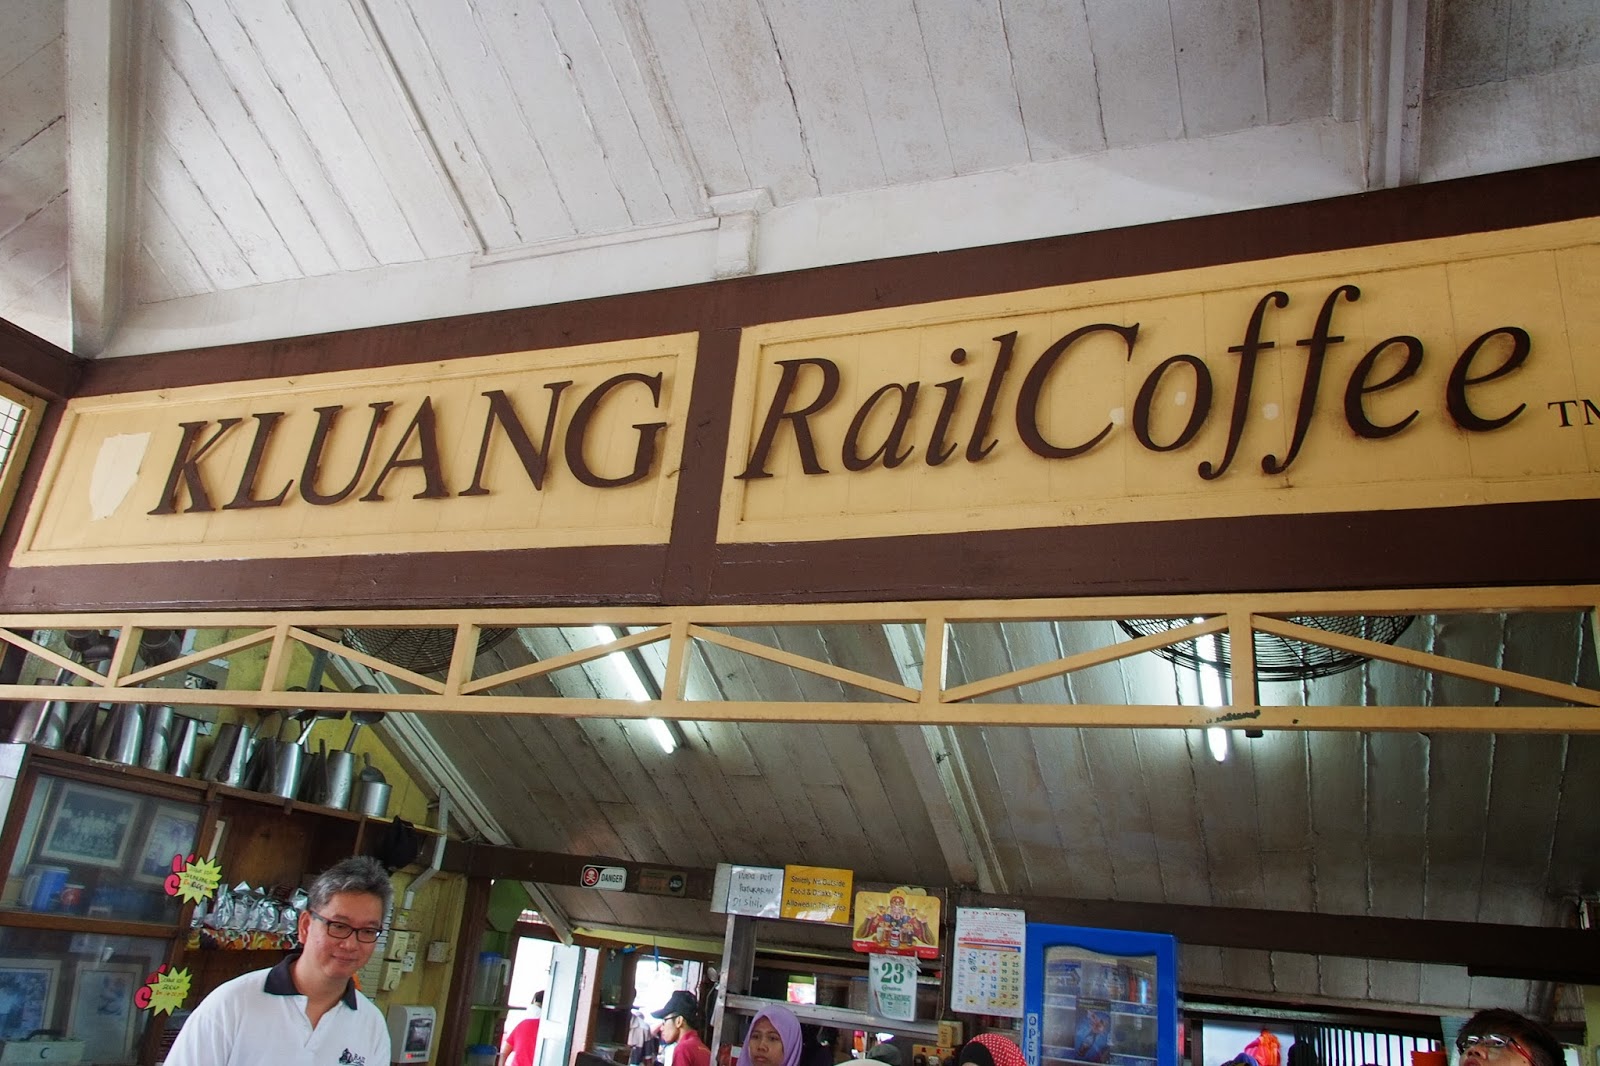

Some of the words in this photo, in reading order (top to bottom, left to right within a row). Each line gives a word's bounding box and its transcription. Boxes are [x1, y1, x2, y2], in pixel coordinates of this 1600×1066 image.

[146, 371, 669, 516] KLUANG
[601, 873, 623, 884] DANGER
[790, 875, 811, 886] Strictly
[822, 878, 846, 888] Outside
[790, 887, 806, 895] Food
[786, 899, 810, 908] Allowed
[880, 962, 905, 984] 23
[1028, 1016, 1037, 1065] OPEN
